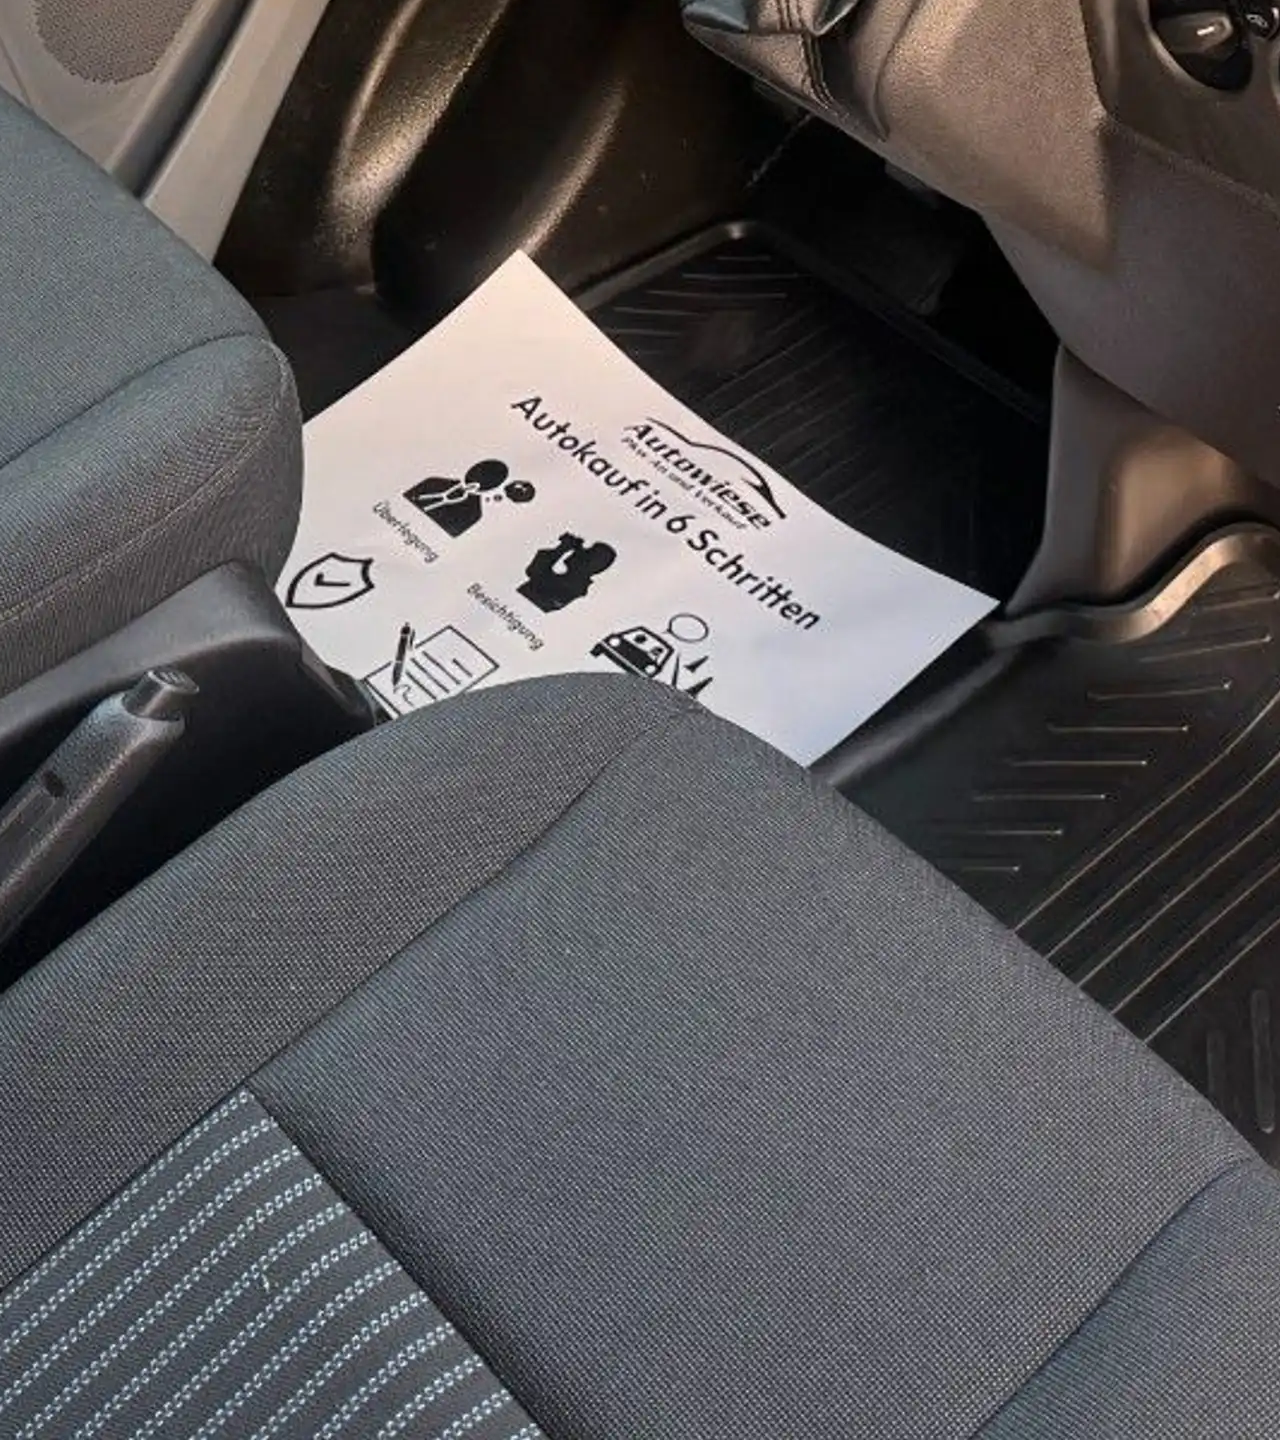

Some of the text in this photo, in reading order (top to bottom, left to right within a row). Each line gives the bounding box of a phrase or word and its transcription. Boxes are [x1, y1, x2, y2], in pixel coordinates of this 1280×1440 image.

[511, 396, 822, 631] Autokauf in 6 Schritten
[623, 423, 772, 529] Autowiese
[373, 500, 439, 564] Überlegung
[467, 582, 544, 652] Besichtigung
